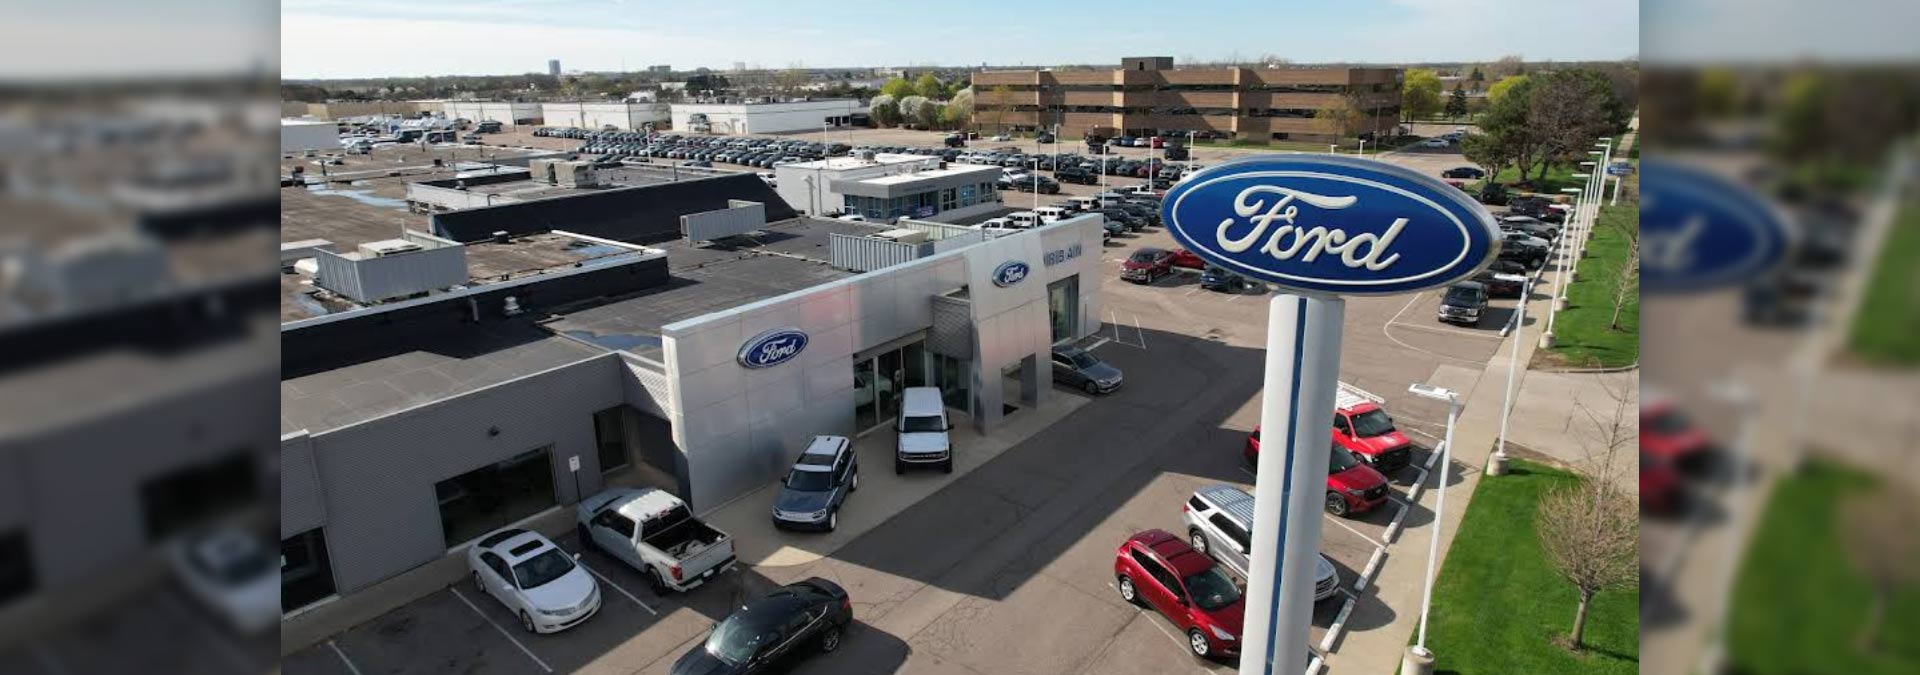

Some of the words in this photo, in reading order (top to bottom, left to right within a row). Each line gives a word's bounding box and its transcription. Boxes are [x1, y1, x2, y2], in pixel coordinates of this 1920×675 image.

[1216, 185, 1410, 271] Ford
[1004, 265, 1025, 283] Ford
[759, 337, 797, 363] Ford
